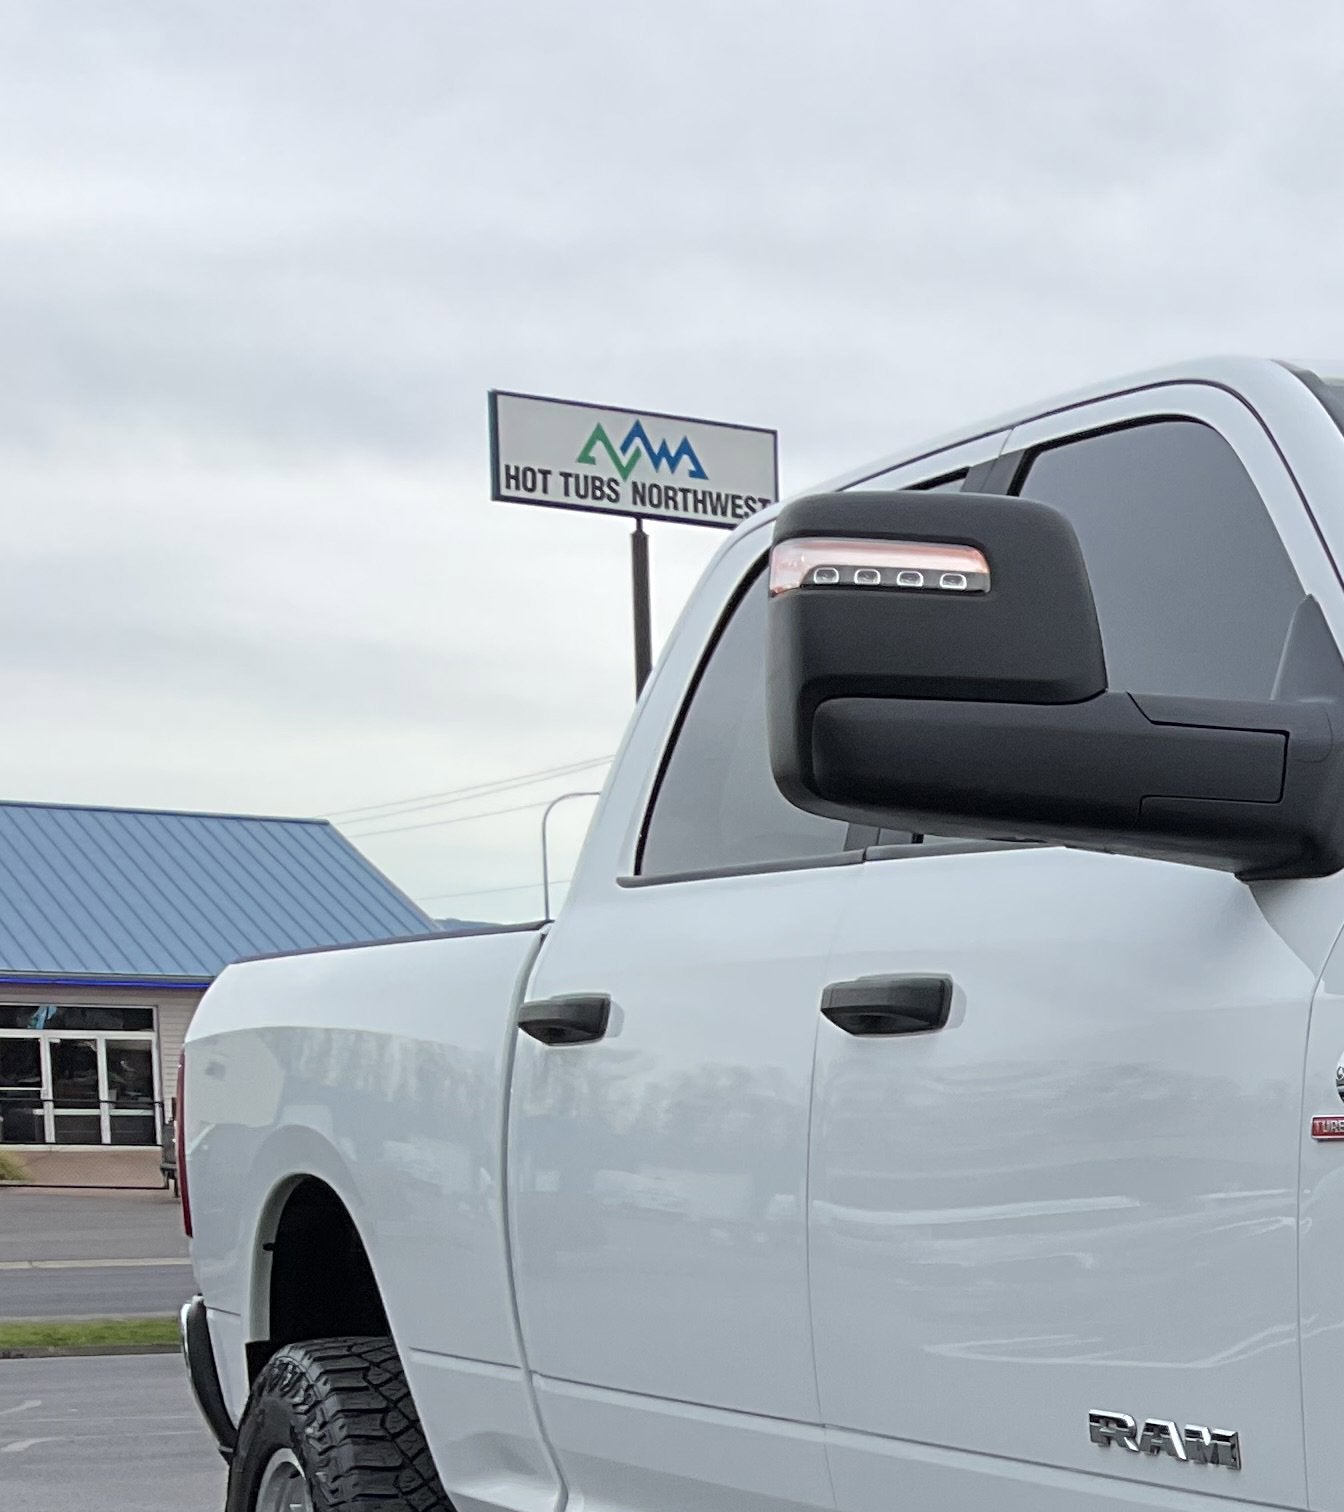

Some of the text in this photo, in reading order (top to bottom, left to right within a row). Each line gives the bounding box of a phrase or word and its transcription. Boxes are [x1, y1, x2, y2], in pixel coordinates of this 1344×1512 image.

[504, 464, 553, 496] HOT
[559, 471, 621, 504] TUBS
[1088, 1408, 1242, 1471] RAM
